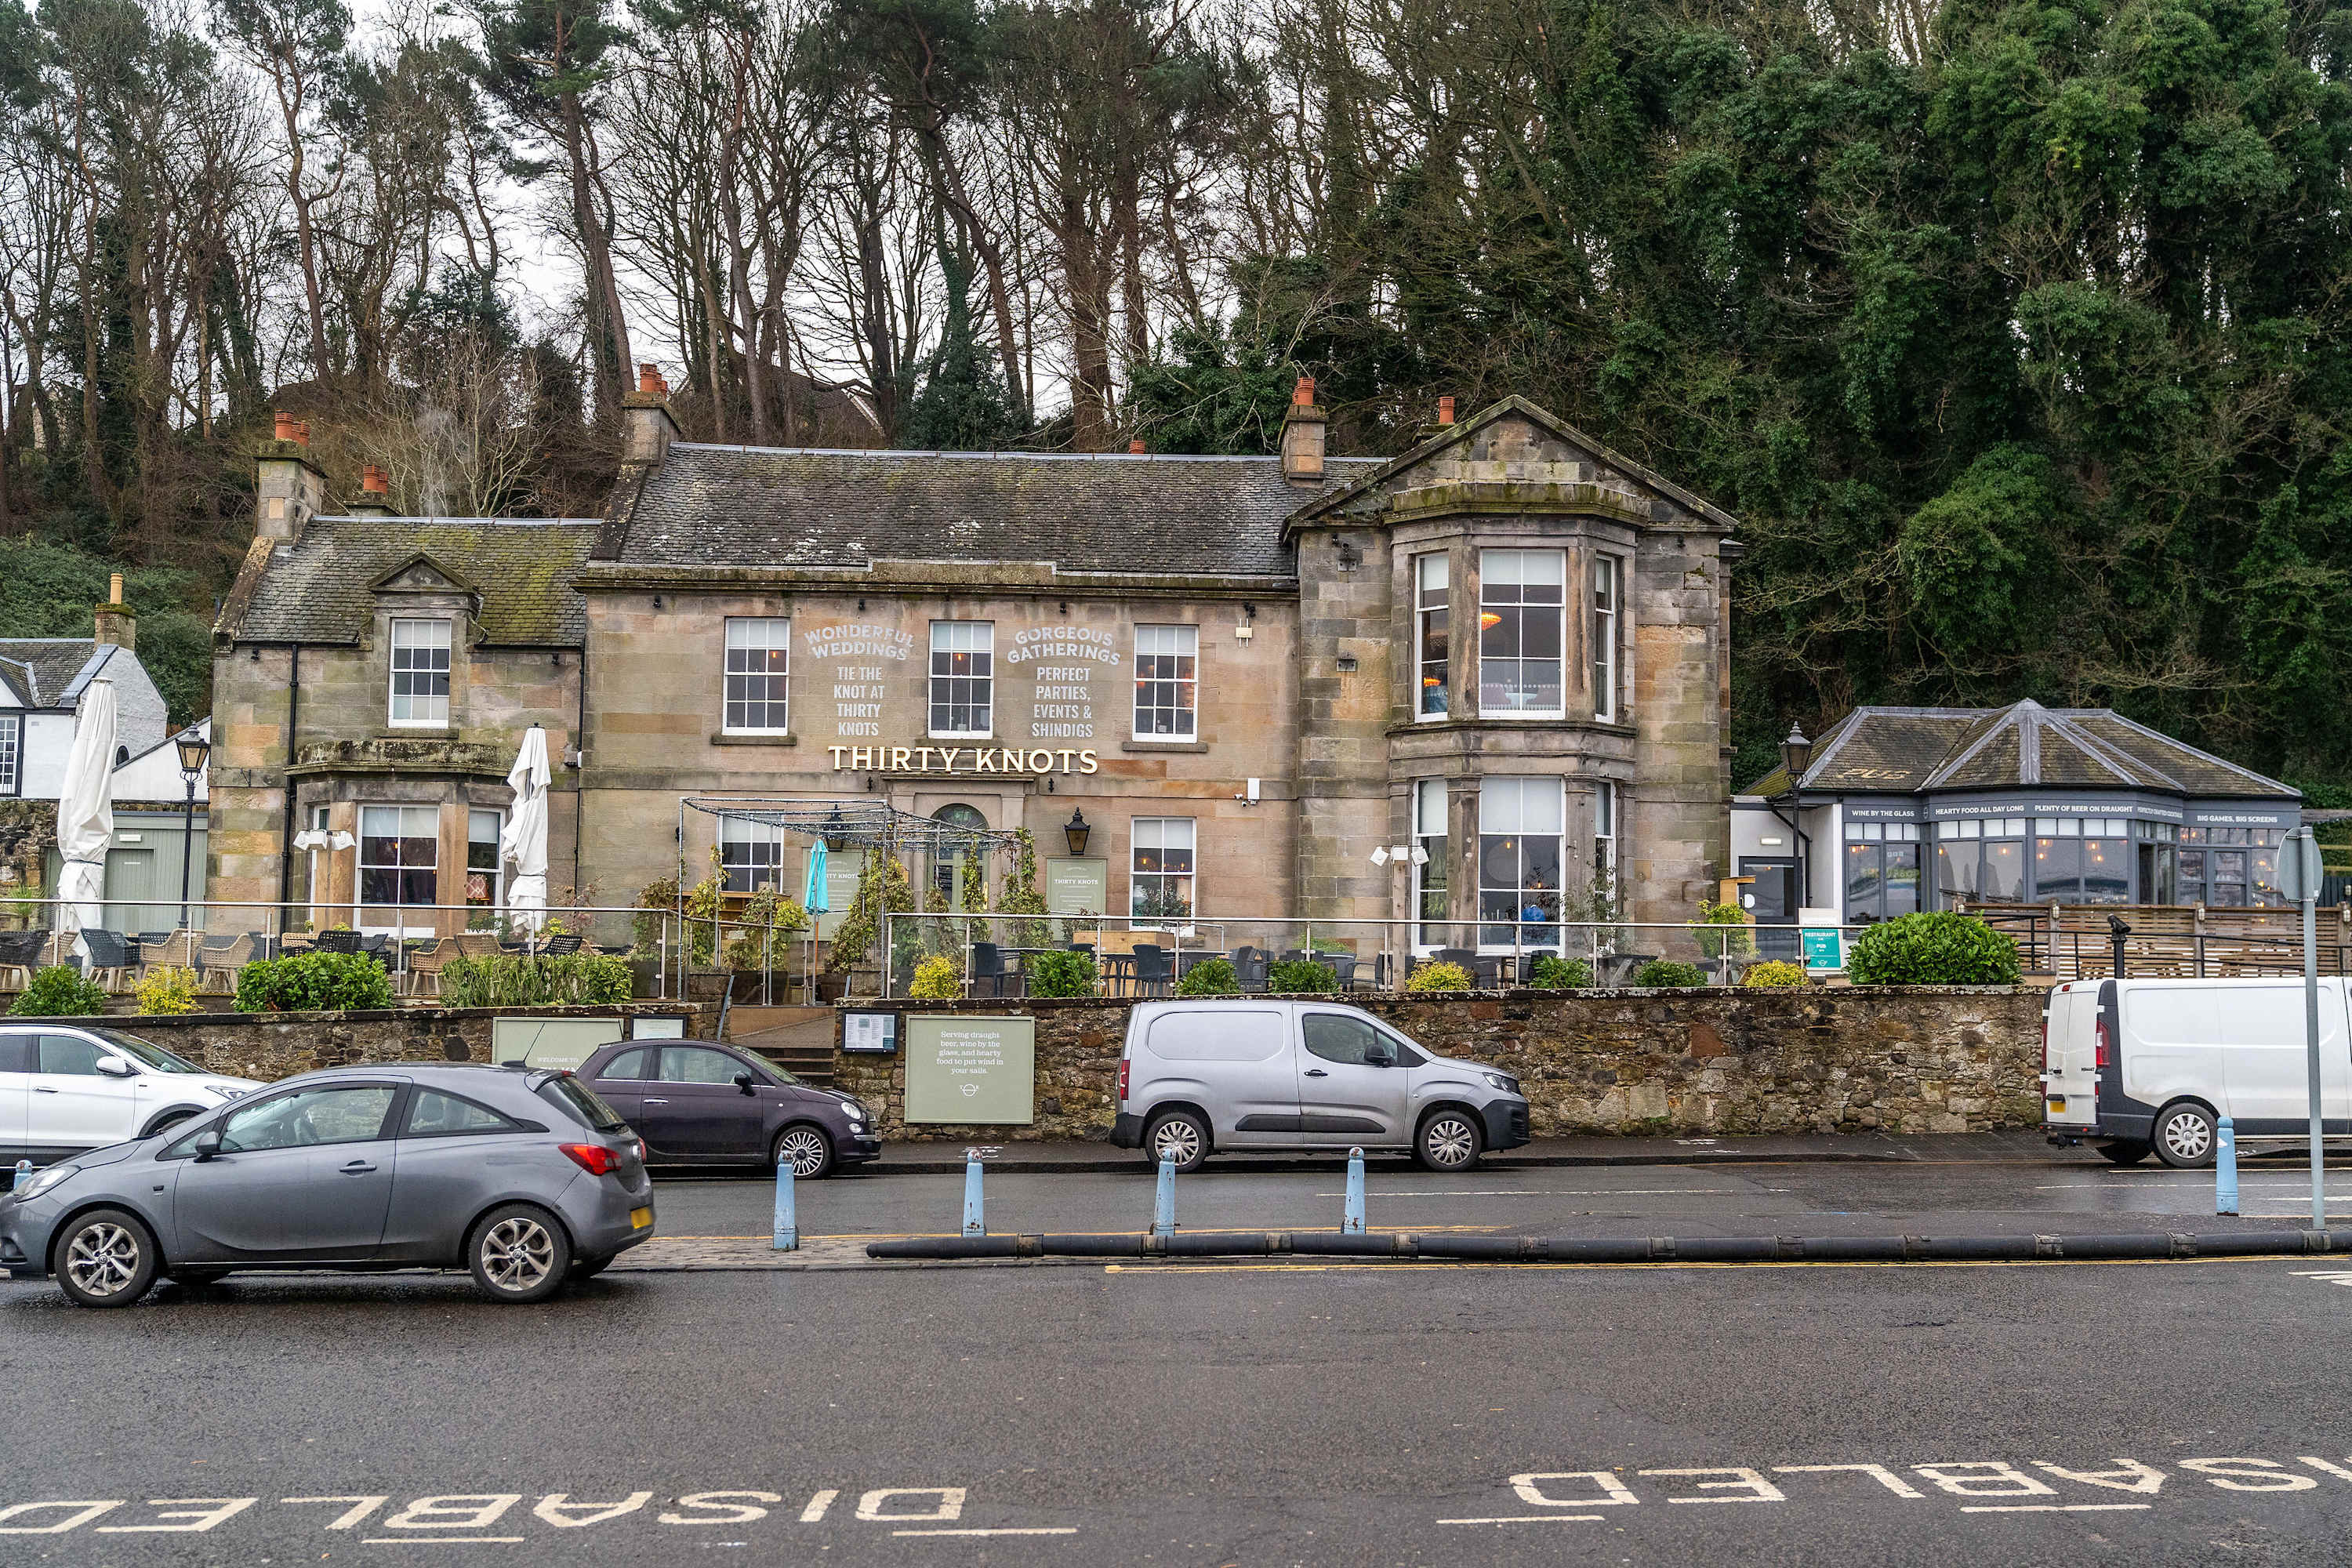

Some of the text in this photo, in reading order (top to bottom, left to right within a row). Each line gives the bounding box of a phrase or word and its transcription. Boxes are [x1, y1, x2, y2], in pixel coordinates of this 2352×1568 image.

[804, 624, 915, 648] WONDERFUL
[1015, 626, 1113, 647] GORGEOUS
[811, 641, 907, 660] WEDDINGS
[1007, 643, 1120, 666] GATHERINGS
[837, 666, 883, 680] TIE THE
[1036, 666, 1091, 681] PERFECT
[833, 684, 885, 699] KNOT AT
[1035, 685, 1091, 701] PARTIES,
[837, 703, 881, 717] THIRTY
[1033, 704, 1092, 719] EVENTS &
[838, 721, 879, 735] KNOTS
[1032, 722, 1093, 738] SHINDIGS
[827, 746, 1098, 775] THIRTY KNOTS
[0, 1487, 967, 1534] DISABLED
